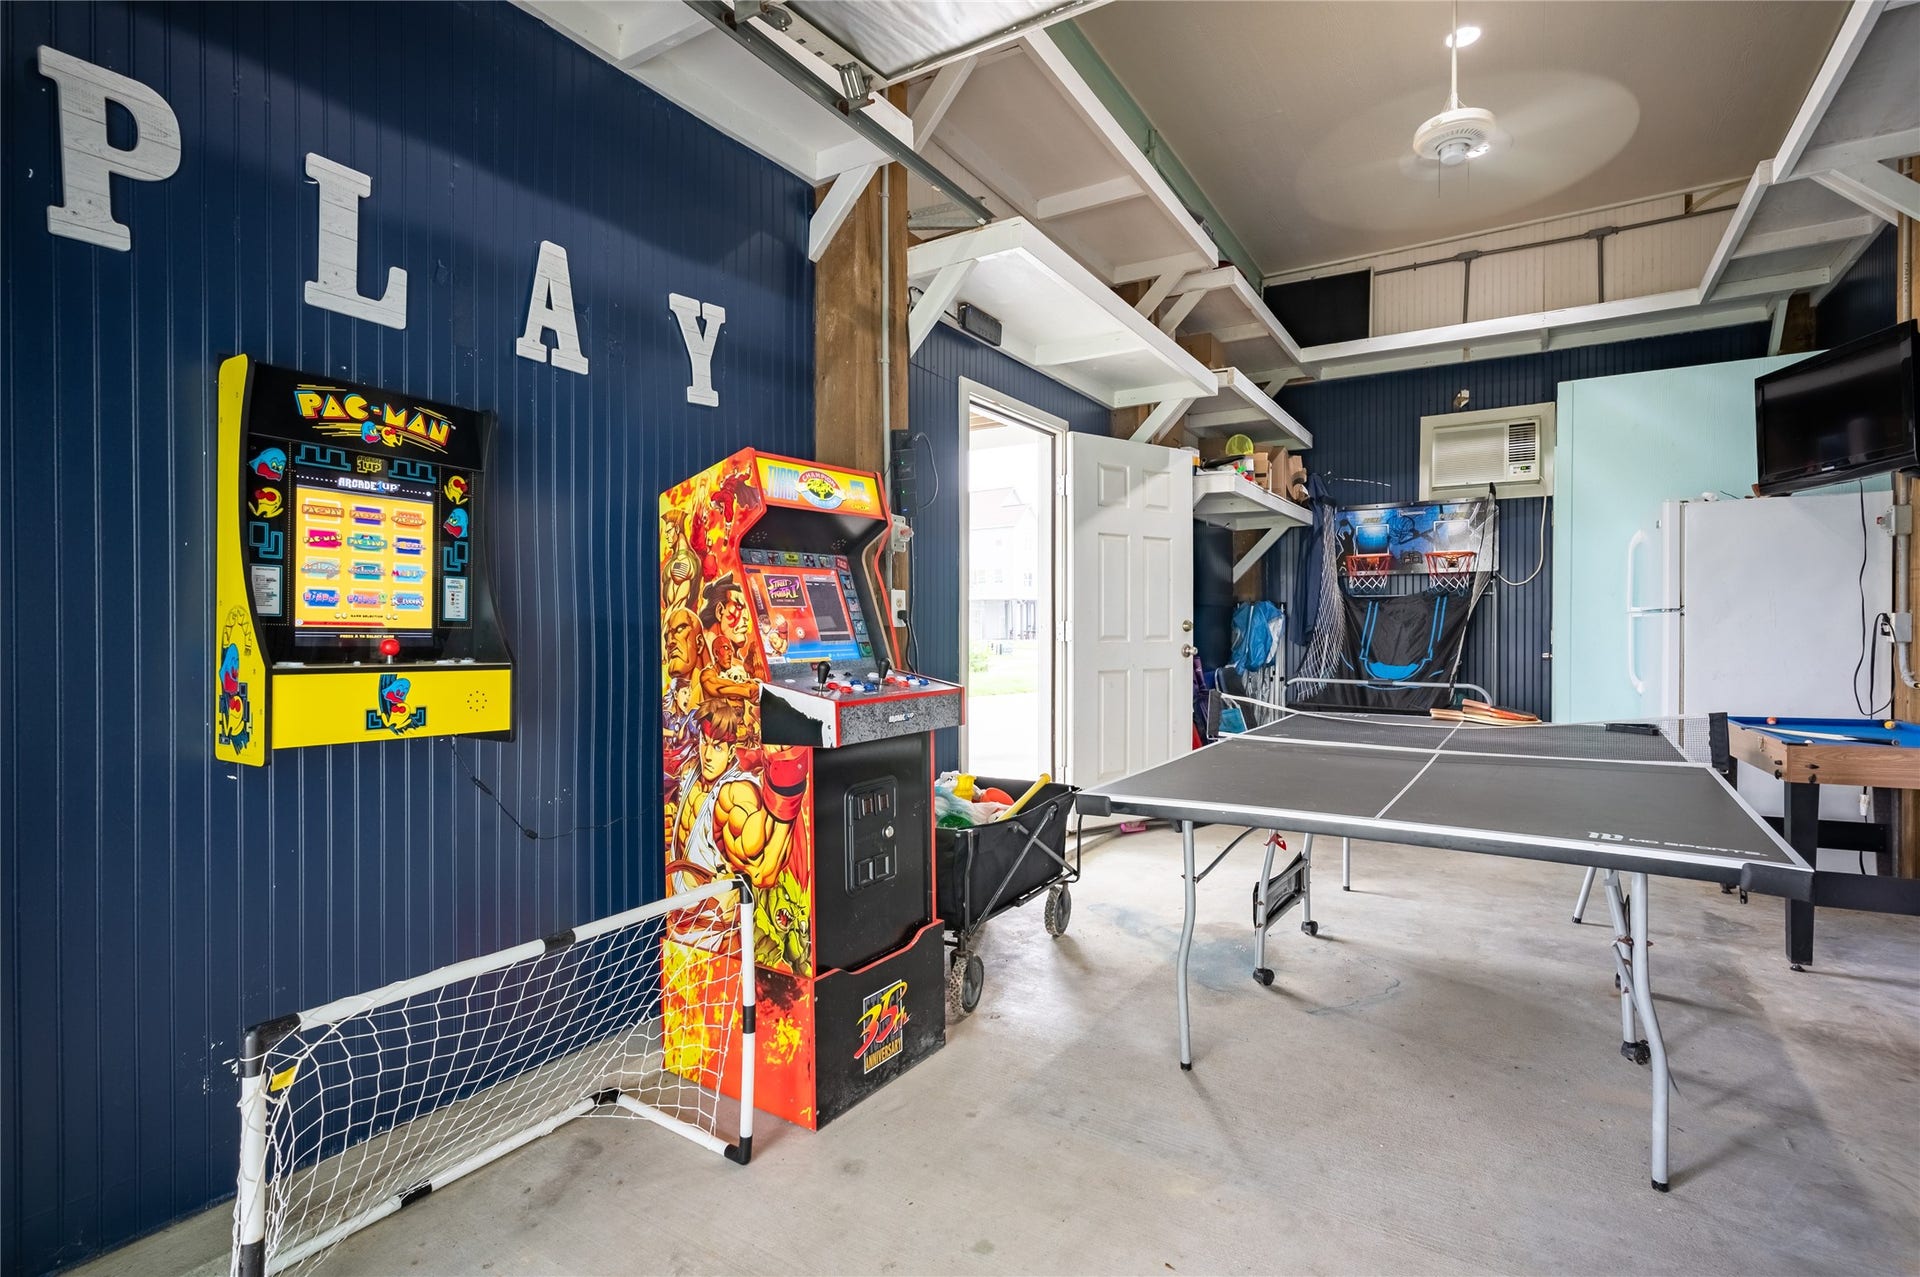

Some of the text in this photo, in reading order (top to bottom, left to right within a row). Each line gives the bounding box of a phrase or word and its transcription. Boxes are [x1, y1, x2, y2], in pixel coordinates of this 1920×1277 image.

[37, 44, 727, 408] PLAY
[294, 390, 450, 446] PAC-MAN
[802, 471, 836, 487] CHAMPION
[303, 505, 343, 517] PAC-MAN
[866, 1038, 901, 1069] ANNIVERSARY
